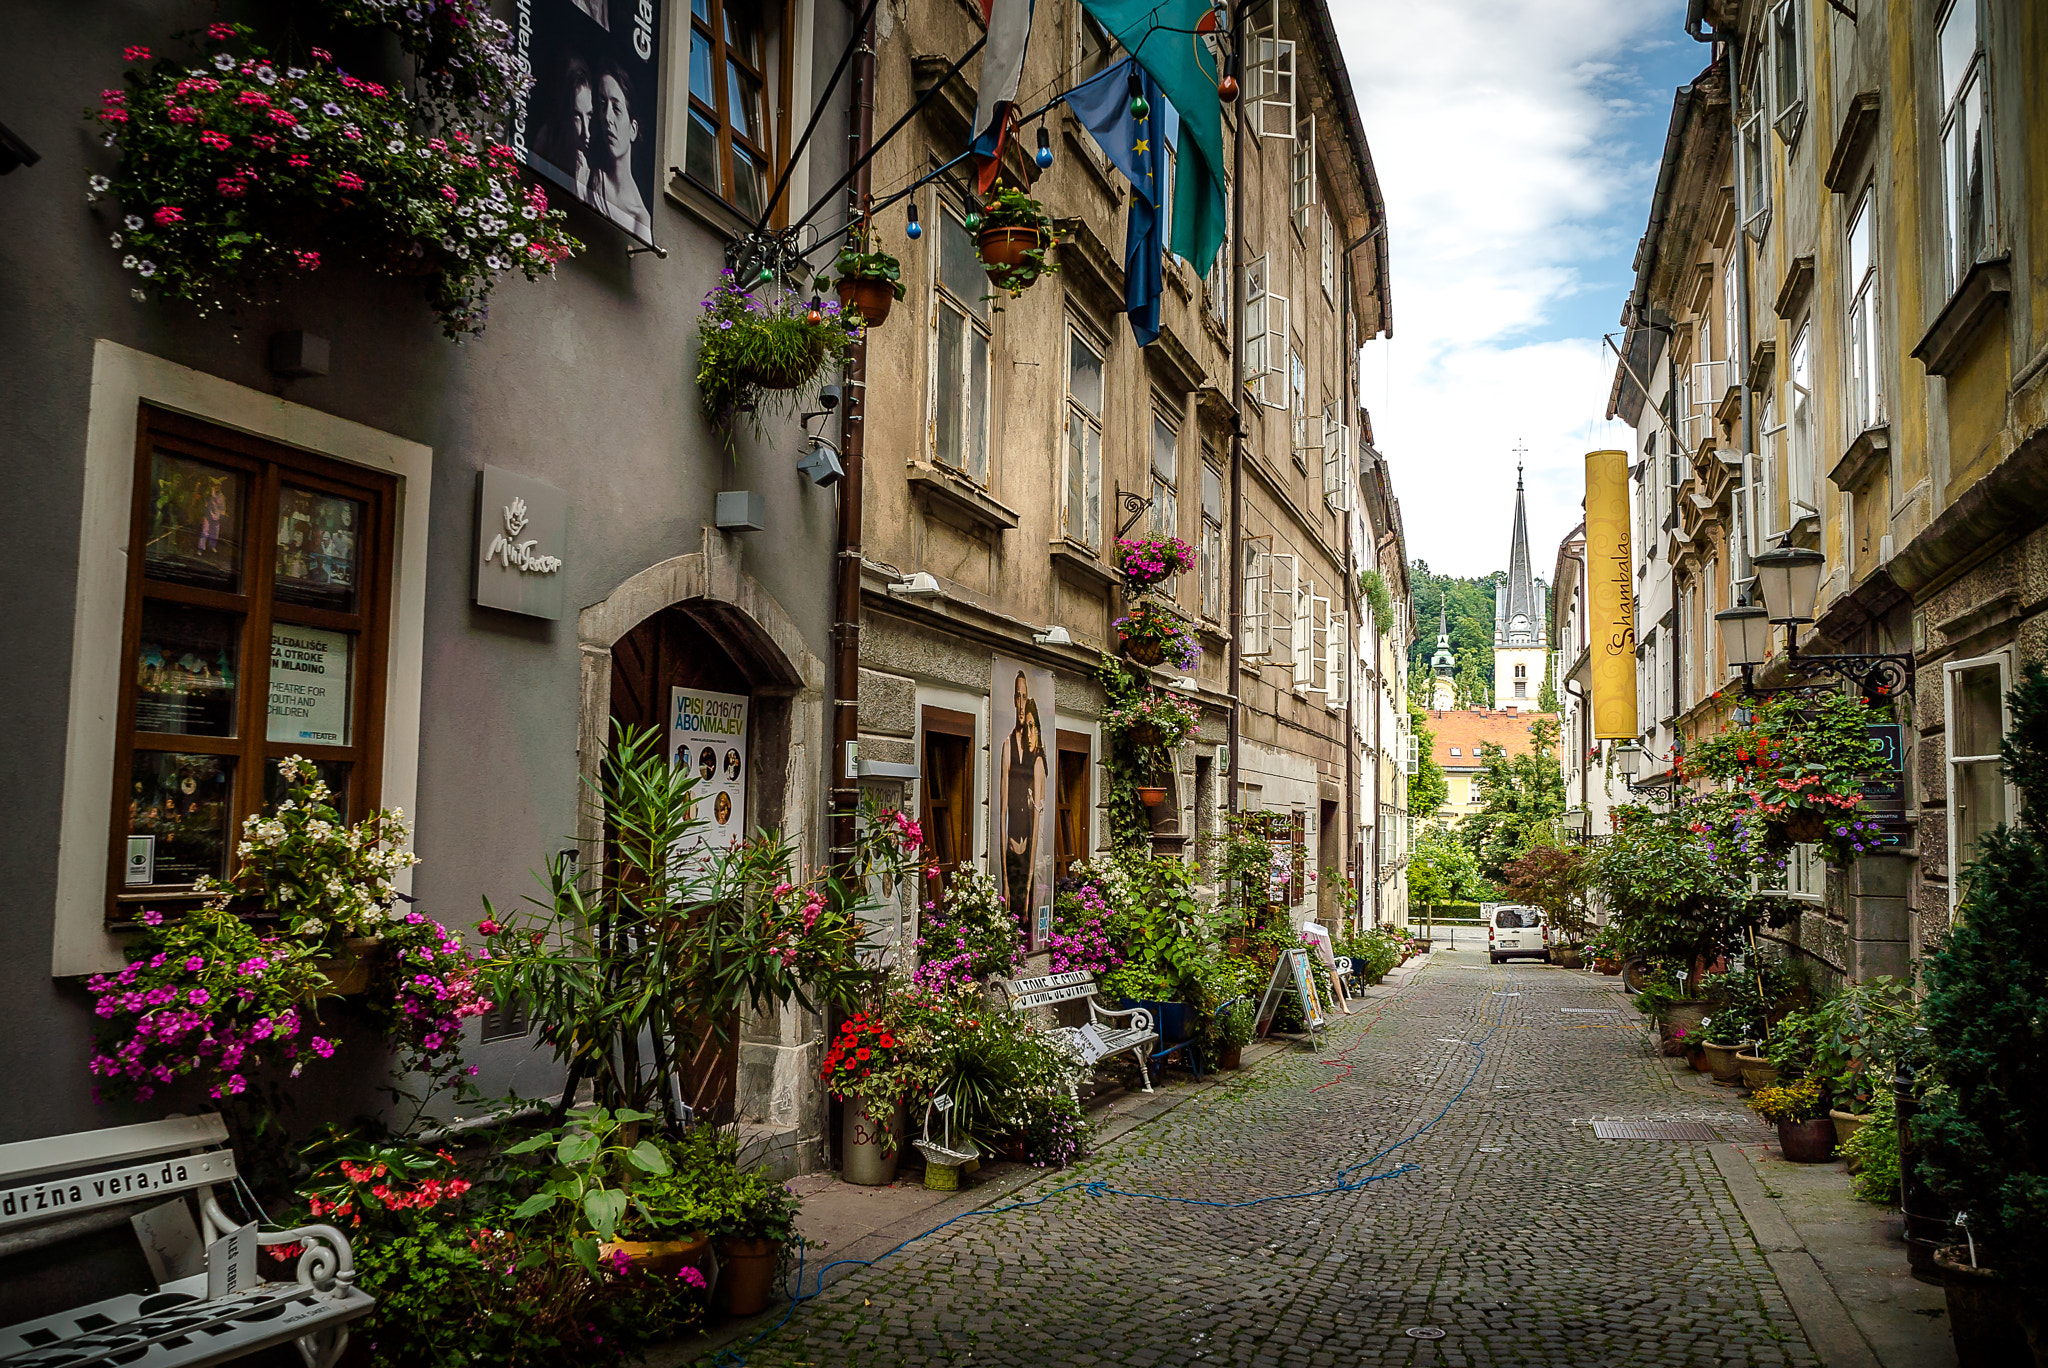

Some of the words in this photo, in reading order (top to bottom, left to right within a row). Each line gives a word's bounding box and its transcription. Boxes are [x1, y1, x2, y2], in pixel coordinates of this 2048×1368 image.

[1606, 532, 1635, 656] Shambala
[271, 635, 329, 652] GLEDALIŠČE
[284, 649, 324, 663] OTROKE
[281, 660, 326, 675] MLADINO
[307, 686, 326, 697] FOR
[297, 697, 316, 707] AND
[677, 695, 704, 715] VPISI
[705, 700, 743, 719] 2016/17
[675, 713, 743, 735] ABONMAJEV
[2, 1185, 82, 1216] držna
